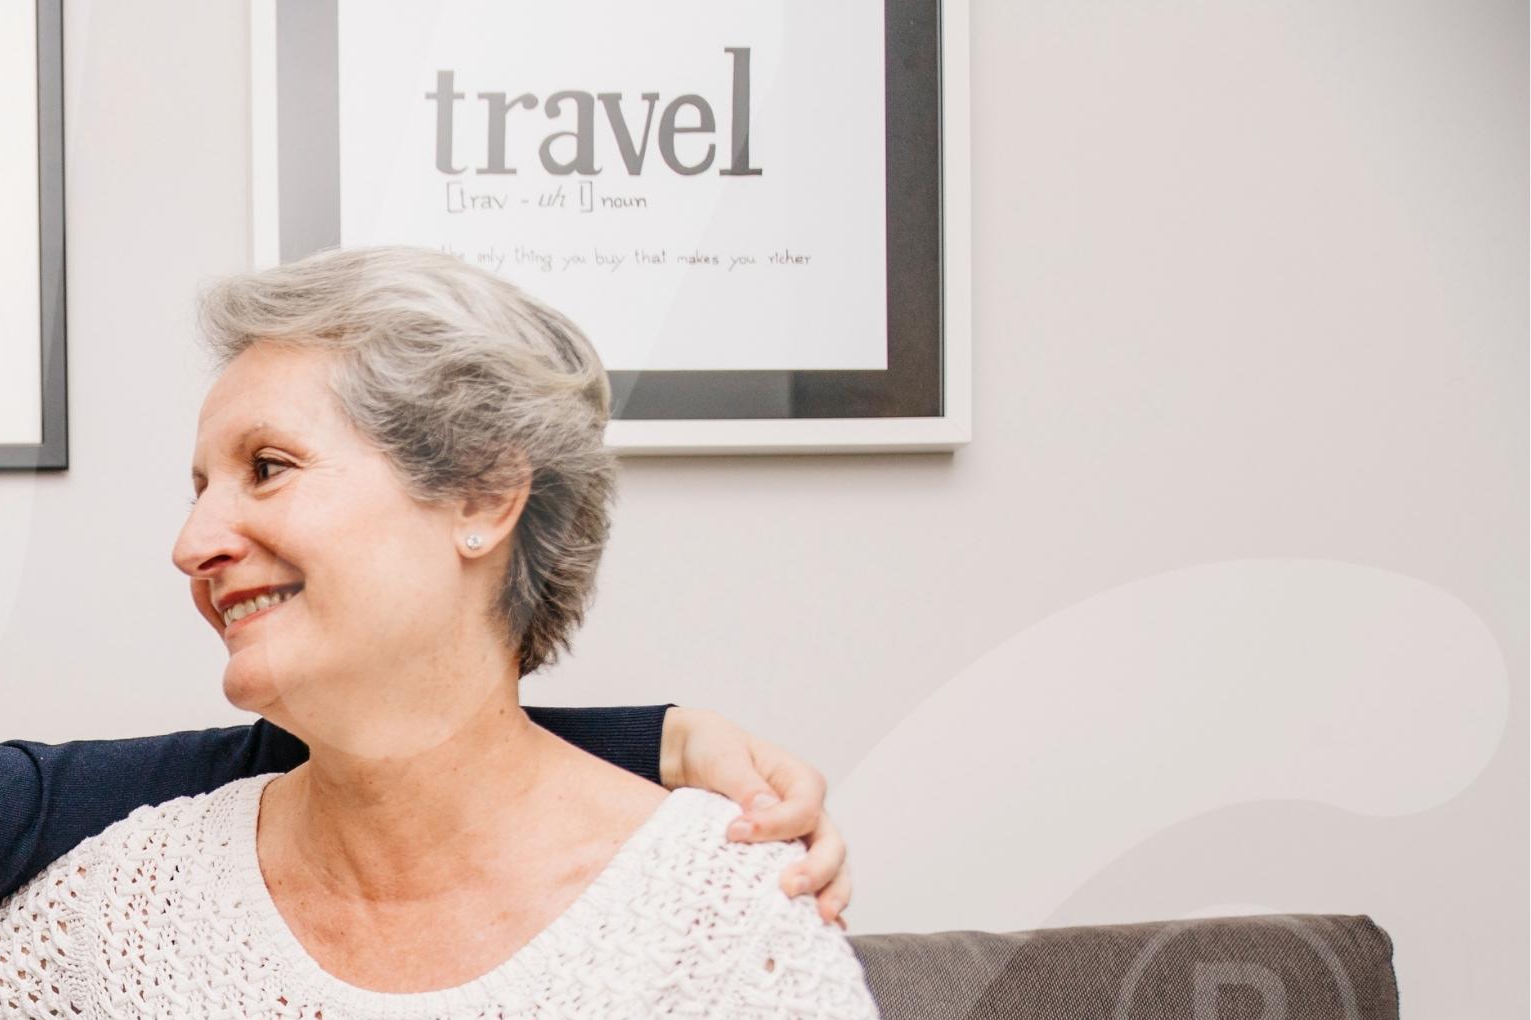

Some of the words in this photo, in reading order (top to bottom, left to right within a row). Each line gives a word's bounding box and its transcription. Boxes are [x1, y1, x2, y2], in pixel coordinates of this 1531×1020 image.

[424, 47, 762, 176] travel
[601, 195, 647, 208] noun
[477, 246, 505, 271] only
[514, 246, 552, 272] thing
[562, 253, 587, 272] you
[595, 247, 625, 272] buy
[635, 248, 666, 265] that
[676, 248, 719, 265] makes
[729, 254, 756, 272] you
[768, 248, 812, 265] richer
